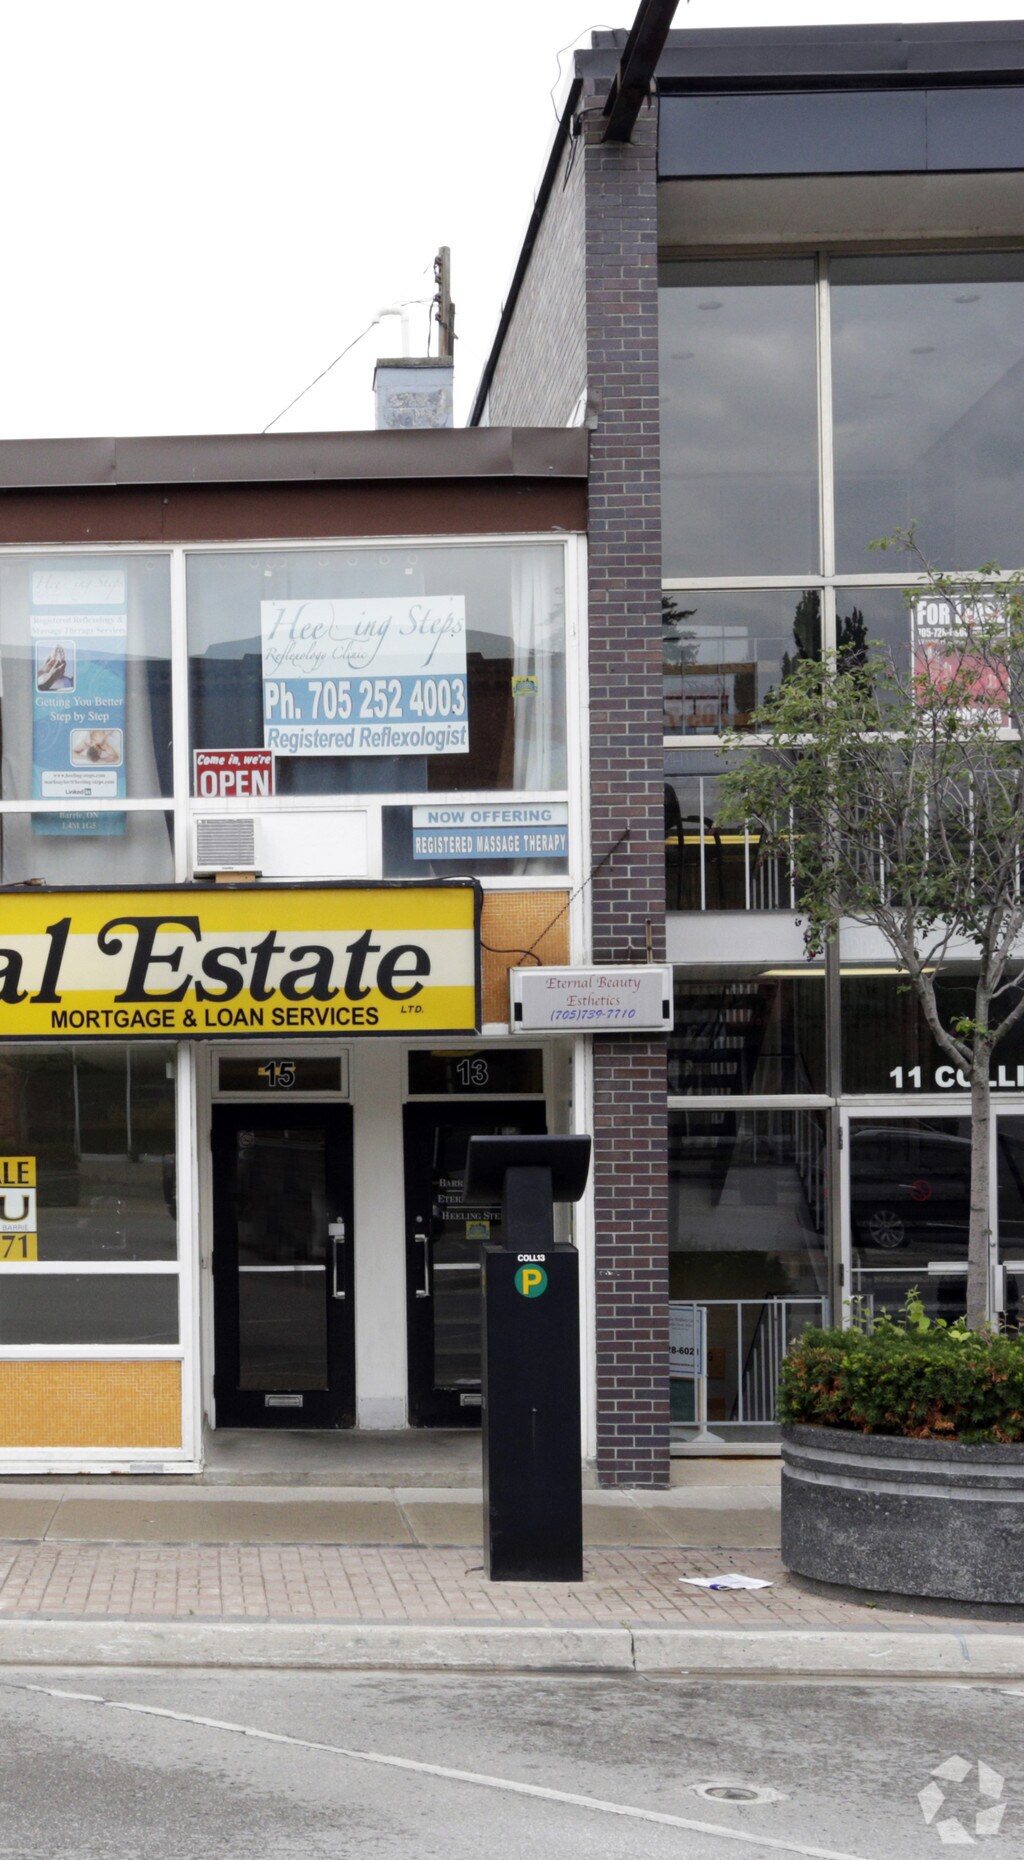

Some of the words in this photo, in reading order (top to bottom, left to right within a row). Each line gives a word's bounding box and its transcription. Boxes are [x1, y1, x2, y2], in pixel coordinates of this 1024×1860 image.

[917, 601, 950, 625] FOR
[399, 604, 464, 667] Steps
[265, 641, 326, 675] Reflexology
[35, 696, 71, 709] Getting
[73, 696, 92, 706] You
[95, 696, 123, 706] Better
[265, 682, 301, 719] Ph.
[308, 681, 352, 719] 705
[359, 680, 403, 718] 252
[409, 679, 466, 716] 4003
[50, 711, 71, 723] Step
[73, 711, 86, 723] by
[88, 711, 110, 723] Step
[267, 727, 355, 753] Registered
[359, 725, 466, 751] Reflexologist
[197, 754, 225, 765] Come
[228, 753, 241, 766] in,
[243, 754, 271, 764] we're
[200, 770, 269, 797] OPEN
[428, 812, 465, 823] NOW
[470, 809, 552, 823] OFFERING
[415, 836, 473, 853] REGISTERED
[476, 835, 520, 852] MASSAGE
[523, 834, 566, 851] THERAPY
[97, 915, 431, 1003] Estate
[546, 975, 592, 989] Eternal
[597, 976, 641, 993] Beauty
[400, 1005, 424, 1013] LTD.
[566, 992, 620, 1007] Esthetics
[51, 1009, 175, 1028] MORTGAGE
[183, 1010, 197, 1027] &
[205, 1008, 263, 1026] LOAN
[271, 1007, 379, 1026] SERVICES
[550, 1008, 636, 1022] (705)739-7710
[264, 1061, 296, 1087] 15
[456, 1059, 489, 1085] 13
[889, 1066, 921, 1088] 11
[442, 1211, 481, 1220] HEELING
[517, 1254, 546, 1262] COLL13
[522, 1268, 542, 1295] P
